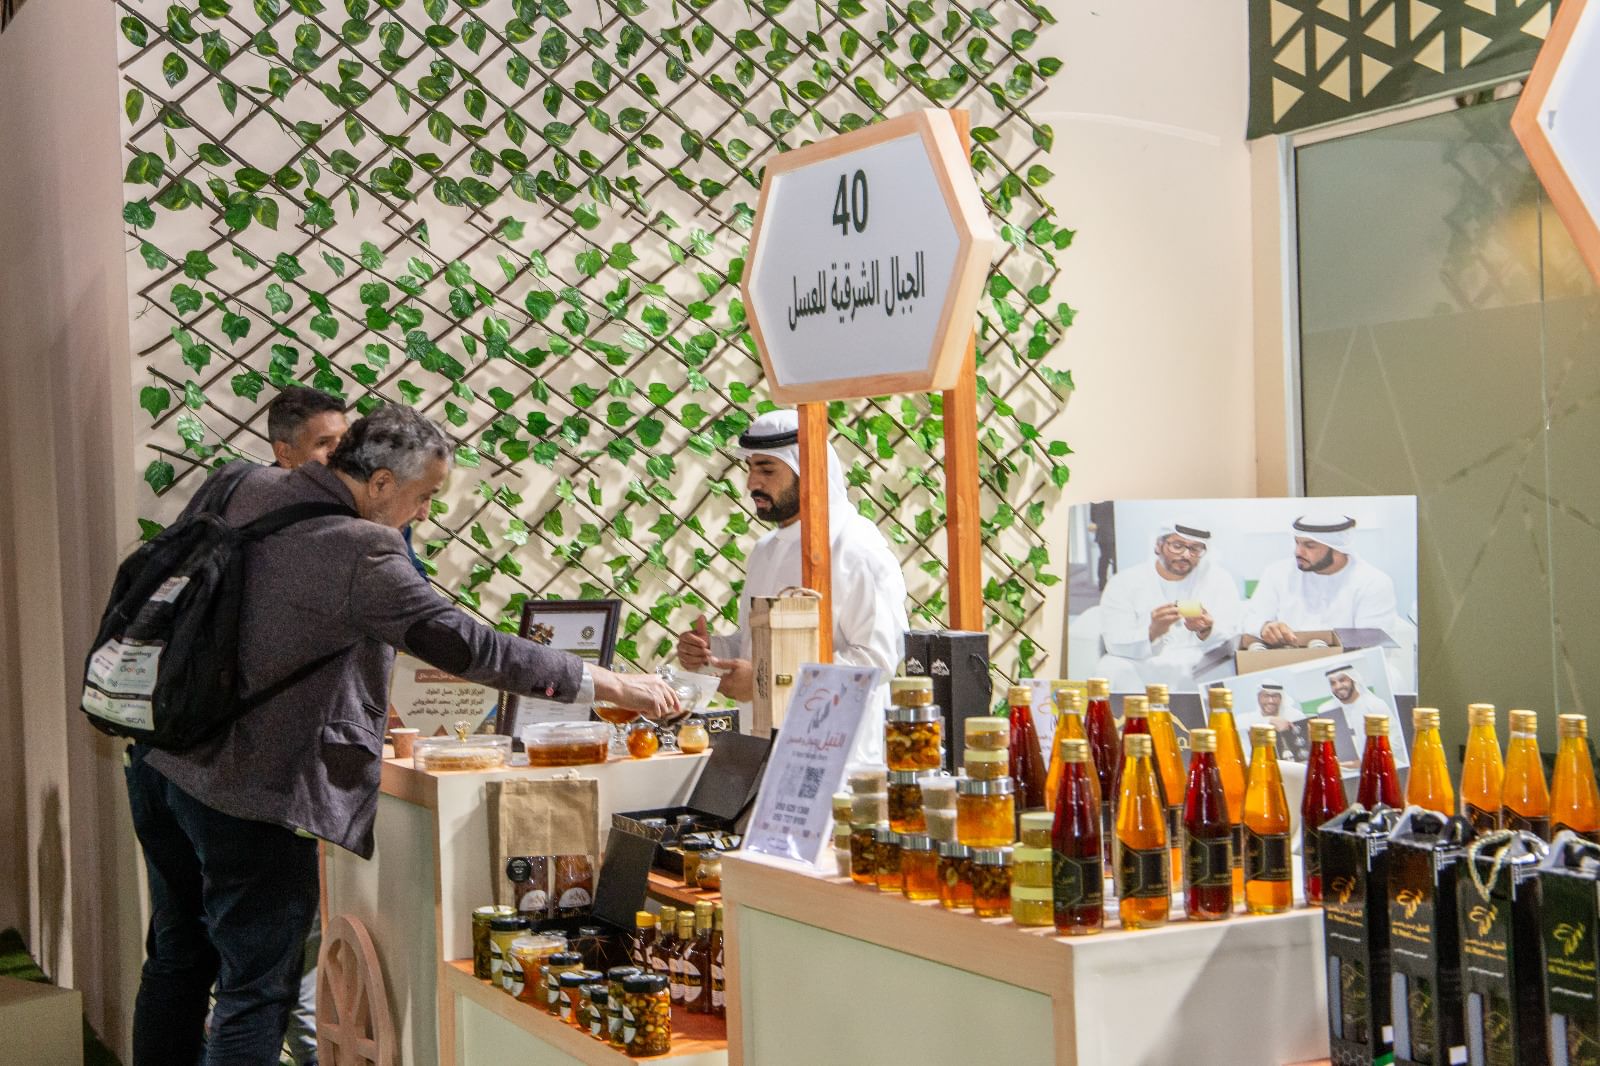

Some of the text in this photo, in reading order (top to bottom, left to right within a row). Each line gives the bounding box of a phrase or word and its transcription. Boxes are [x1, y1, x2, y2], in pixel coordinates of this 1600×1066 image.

[832, 169, 870, 236] 40
[788, 251, 926, 332] الجبال الشرقية للعسل
